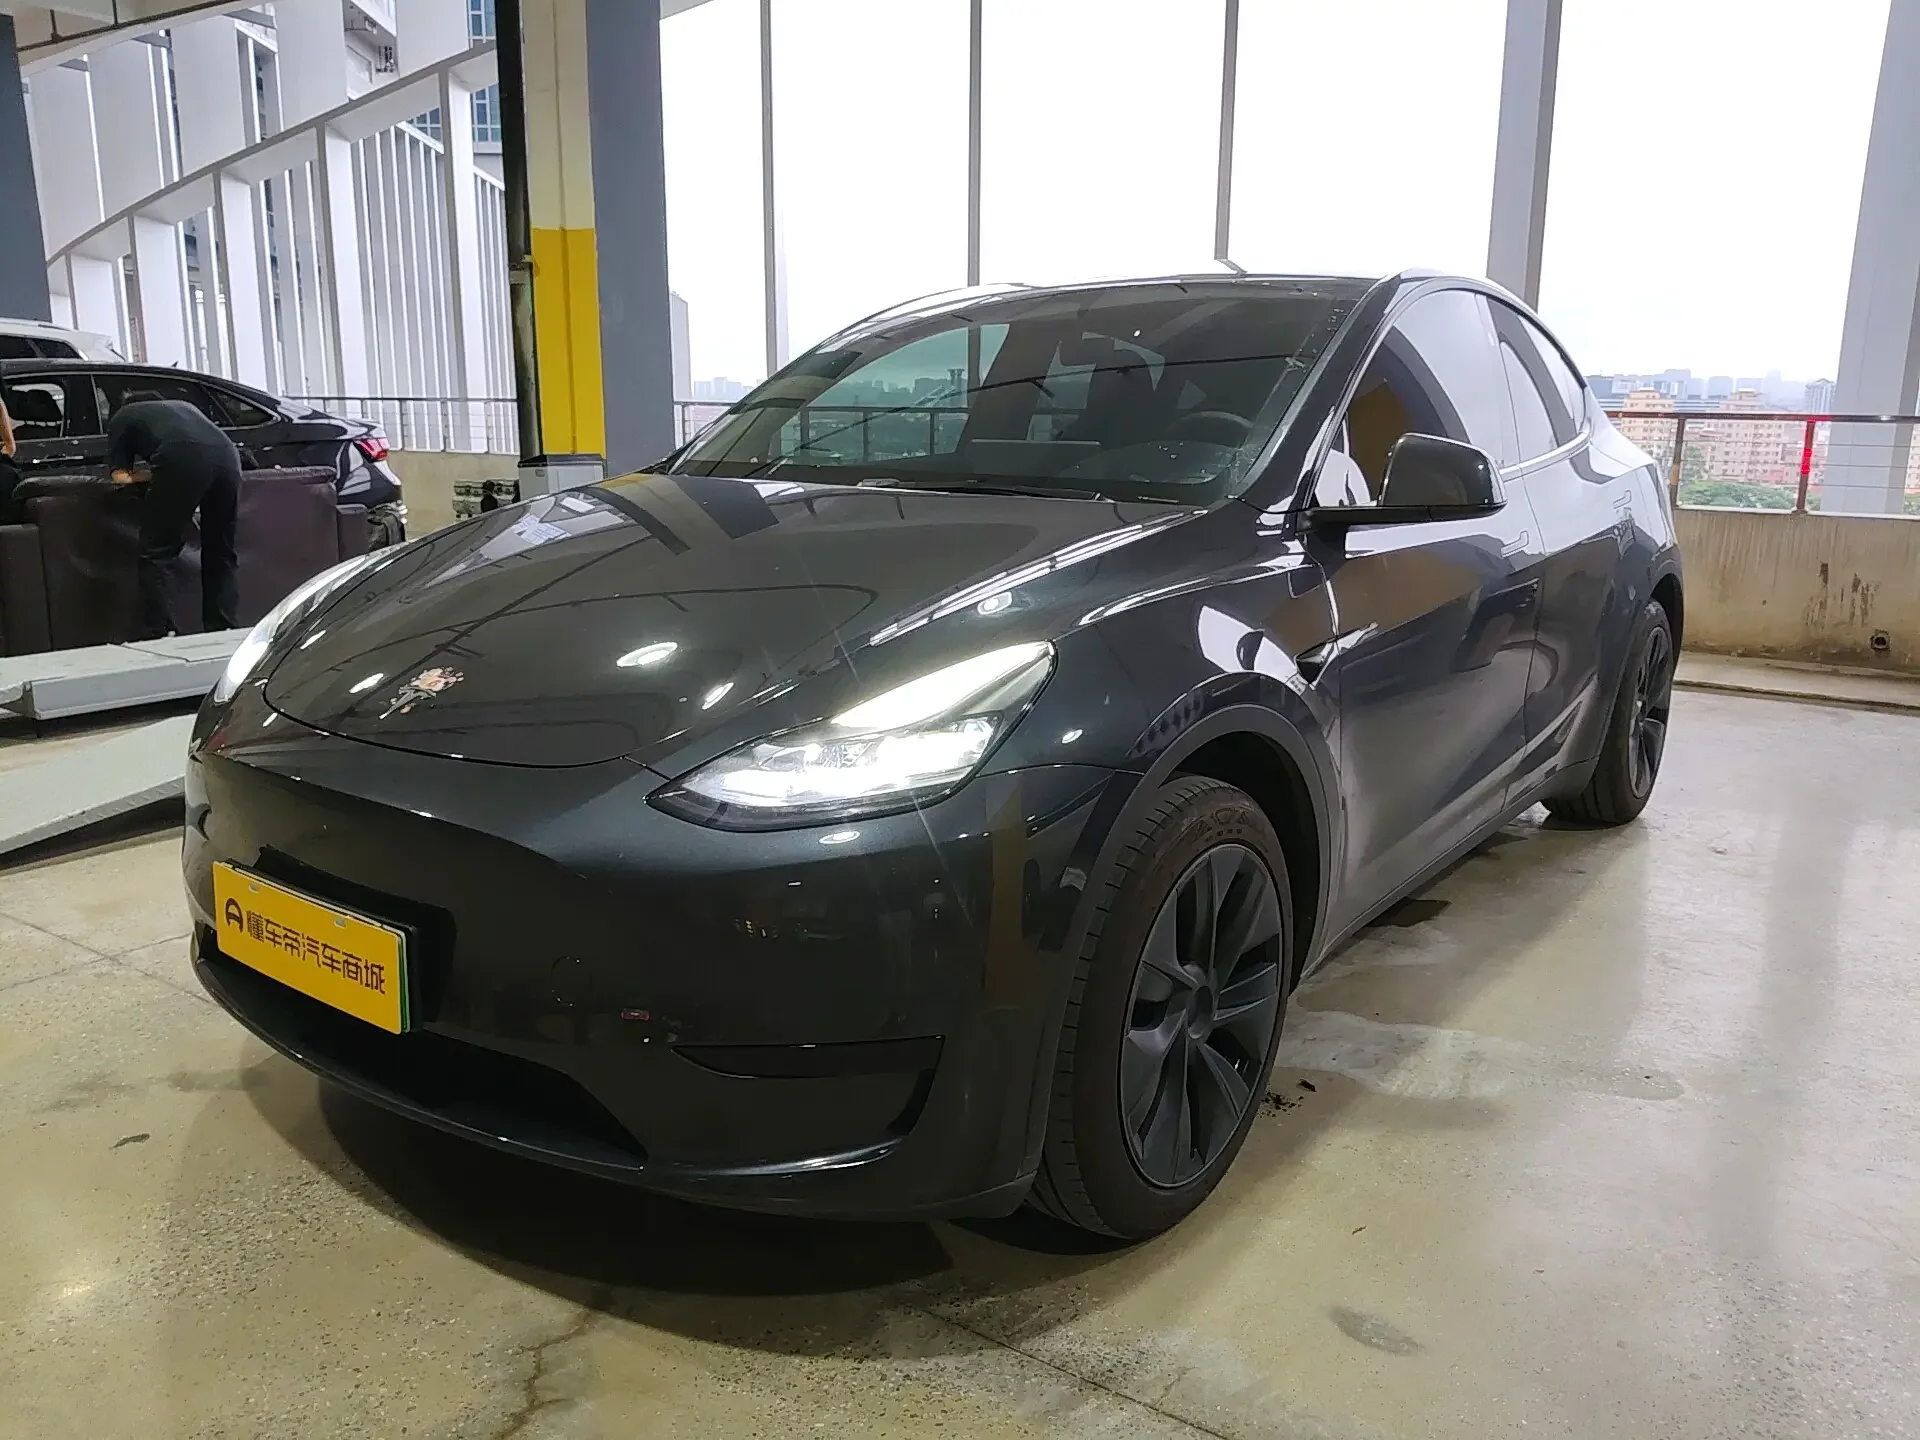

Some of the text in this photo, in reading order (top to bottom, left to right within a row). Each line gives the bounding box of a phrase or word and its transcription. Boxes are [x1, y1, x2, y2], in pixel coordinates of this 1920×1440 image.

[247, 911, 386, 995] 懂车帝汽车商城
